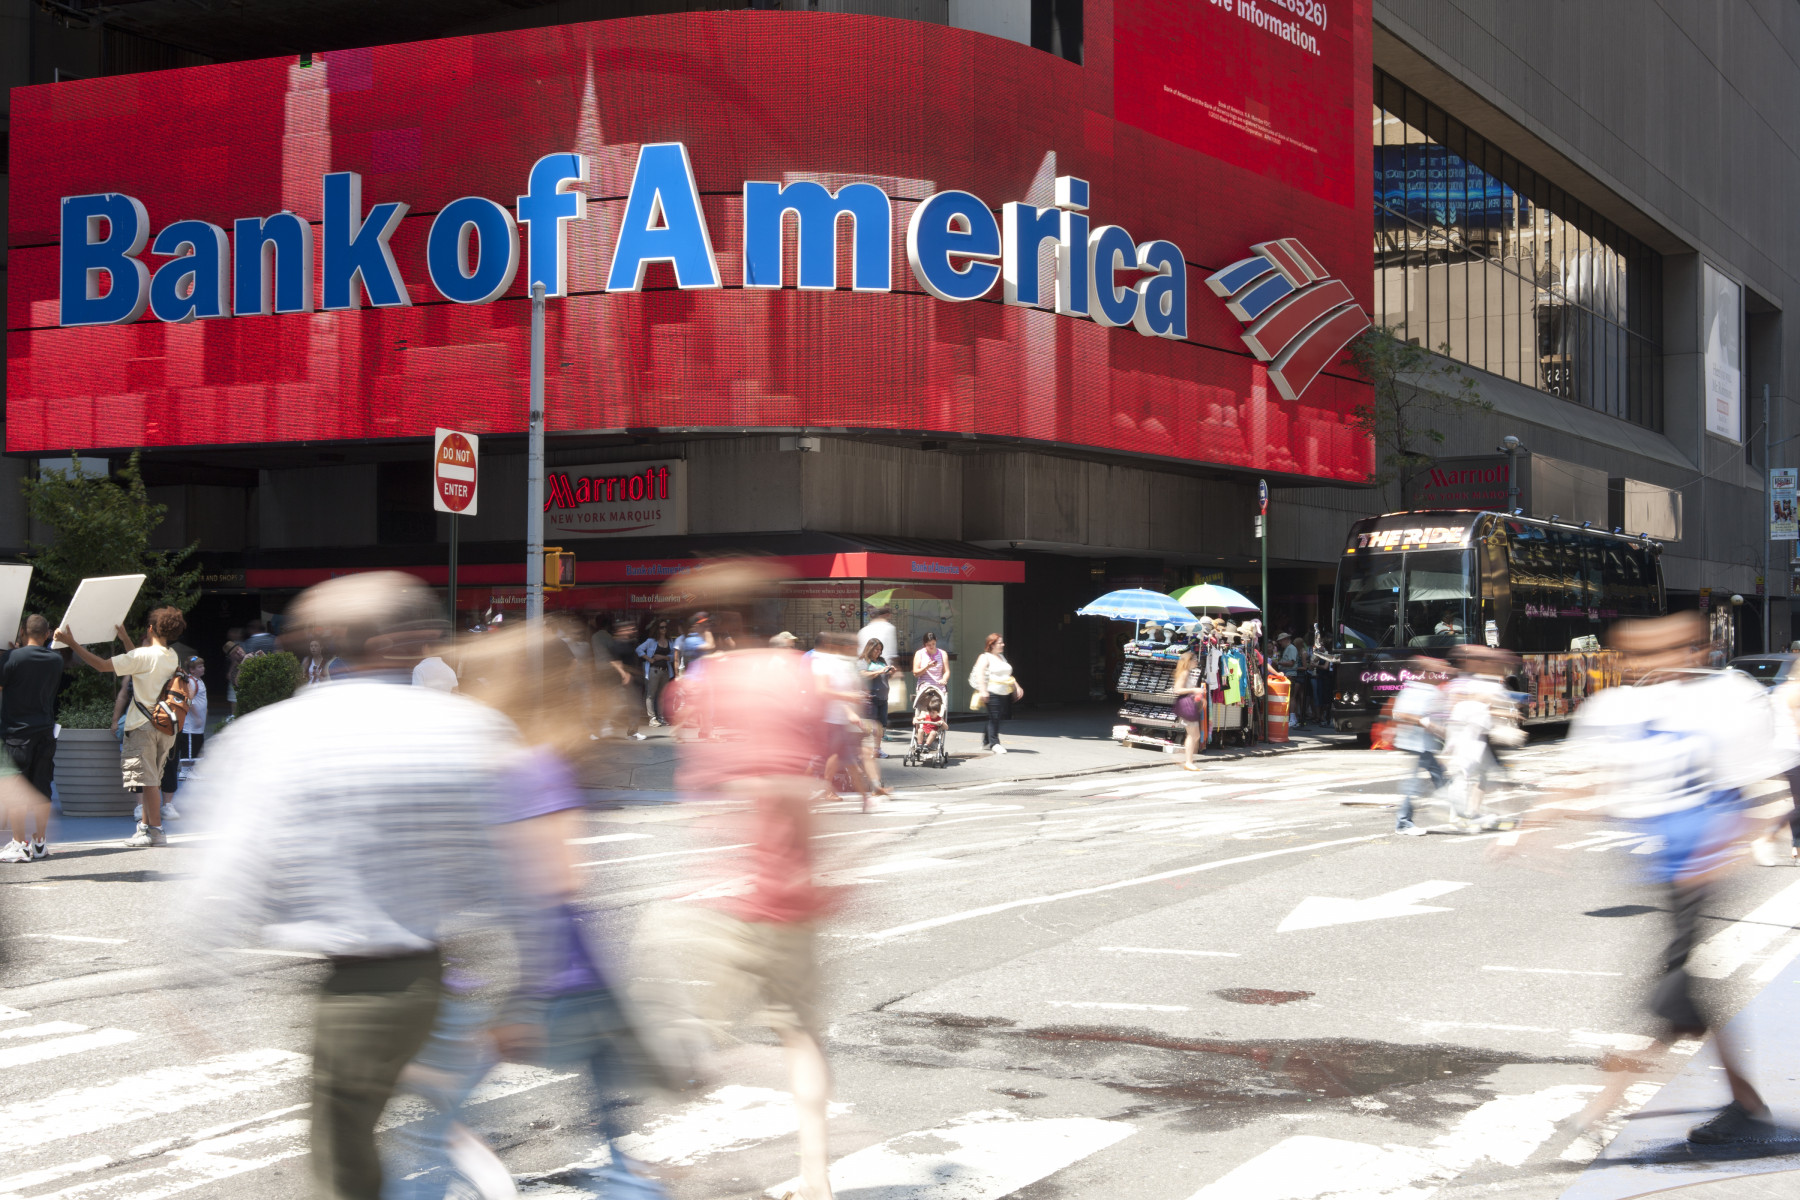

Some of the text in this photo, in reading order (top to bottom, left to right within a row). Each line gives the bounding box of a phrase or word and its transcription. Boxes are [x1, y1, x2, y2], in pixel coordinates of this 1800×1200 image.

[1237, 0, 1321, 56] information.
[60, 141, 1188, 341] Bank of America
[443, 447, 470, 463] DO NOT
[1424, 464, 1510, 490] Marriott
[444, 483, 468, 498] ENTER
[544, 465, 671, 512] Marriott
[1440, 491, 1469, 501] YORK
[551, 509, 662, 525] NEW YORK MARQUIS
[1403, 526, 1465, 545] RIDE
[626, 564, 647, 575] Bank
[648, 564, 656, 575] of
[912, 561, 960, 575] Bank of America
[219, 574, 238, 582] SHOPS
[631, 593, 647, 603] Bank
[655, 593, 681, 603] America
[1361, 671, 1378, 683] Get
[1400, 669, 1426, 682] Find
